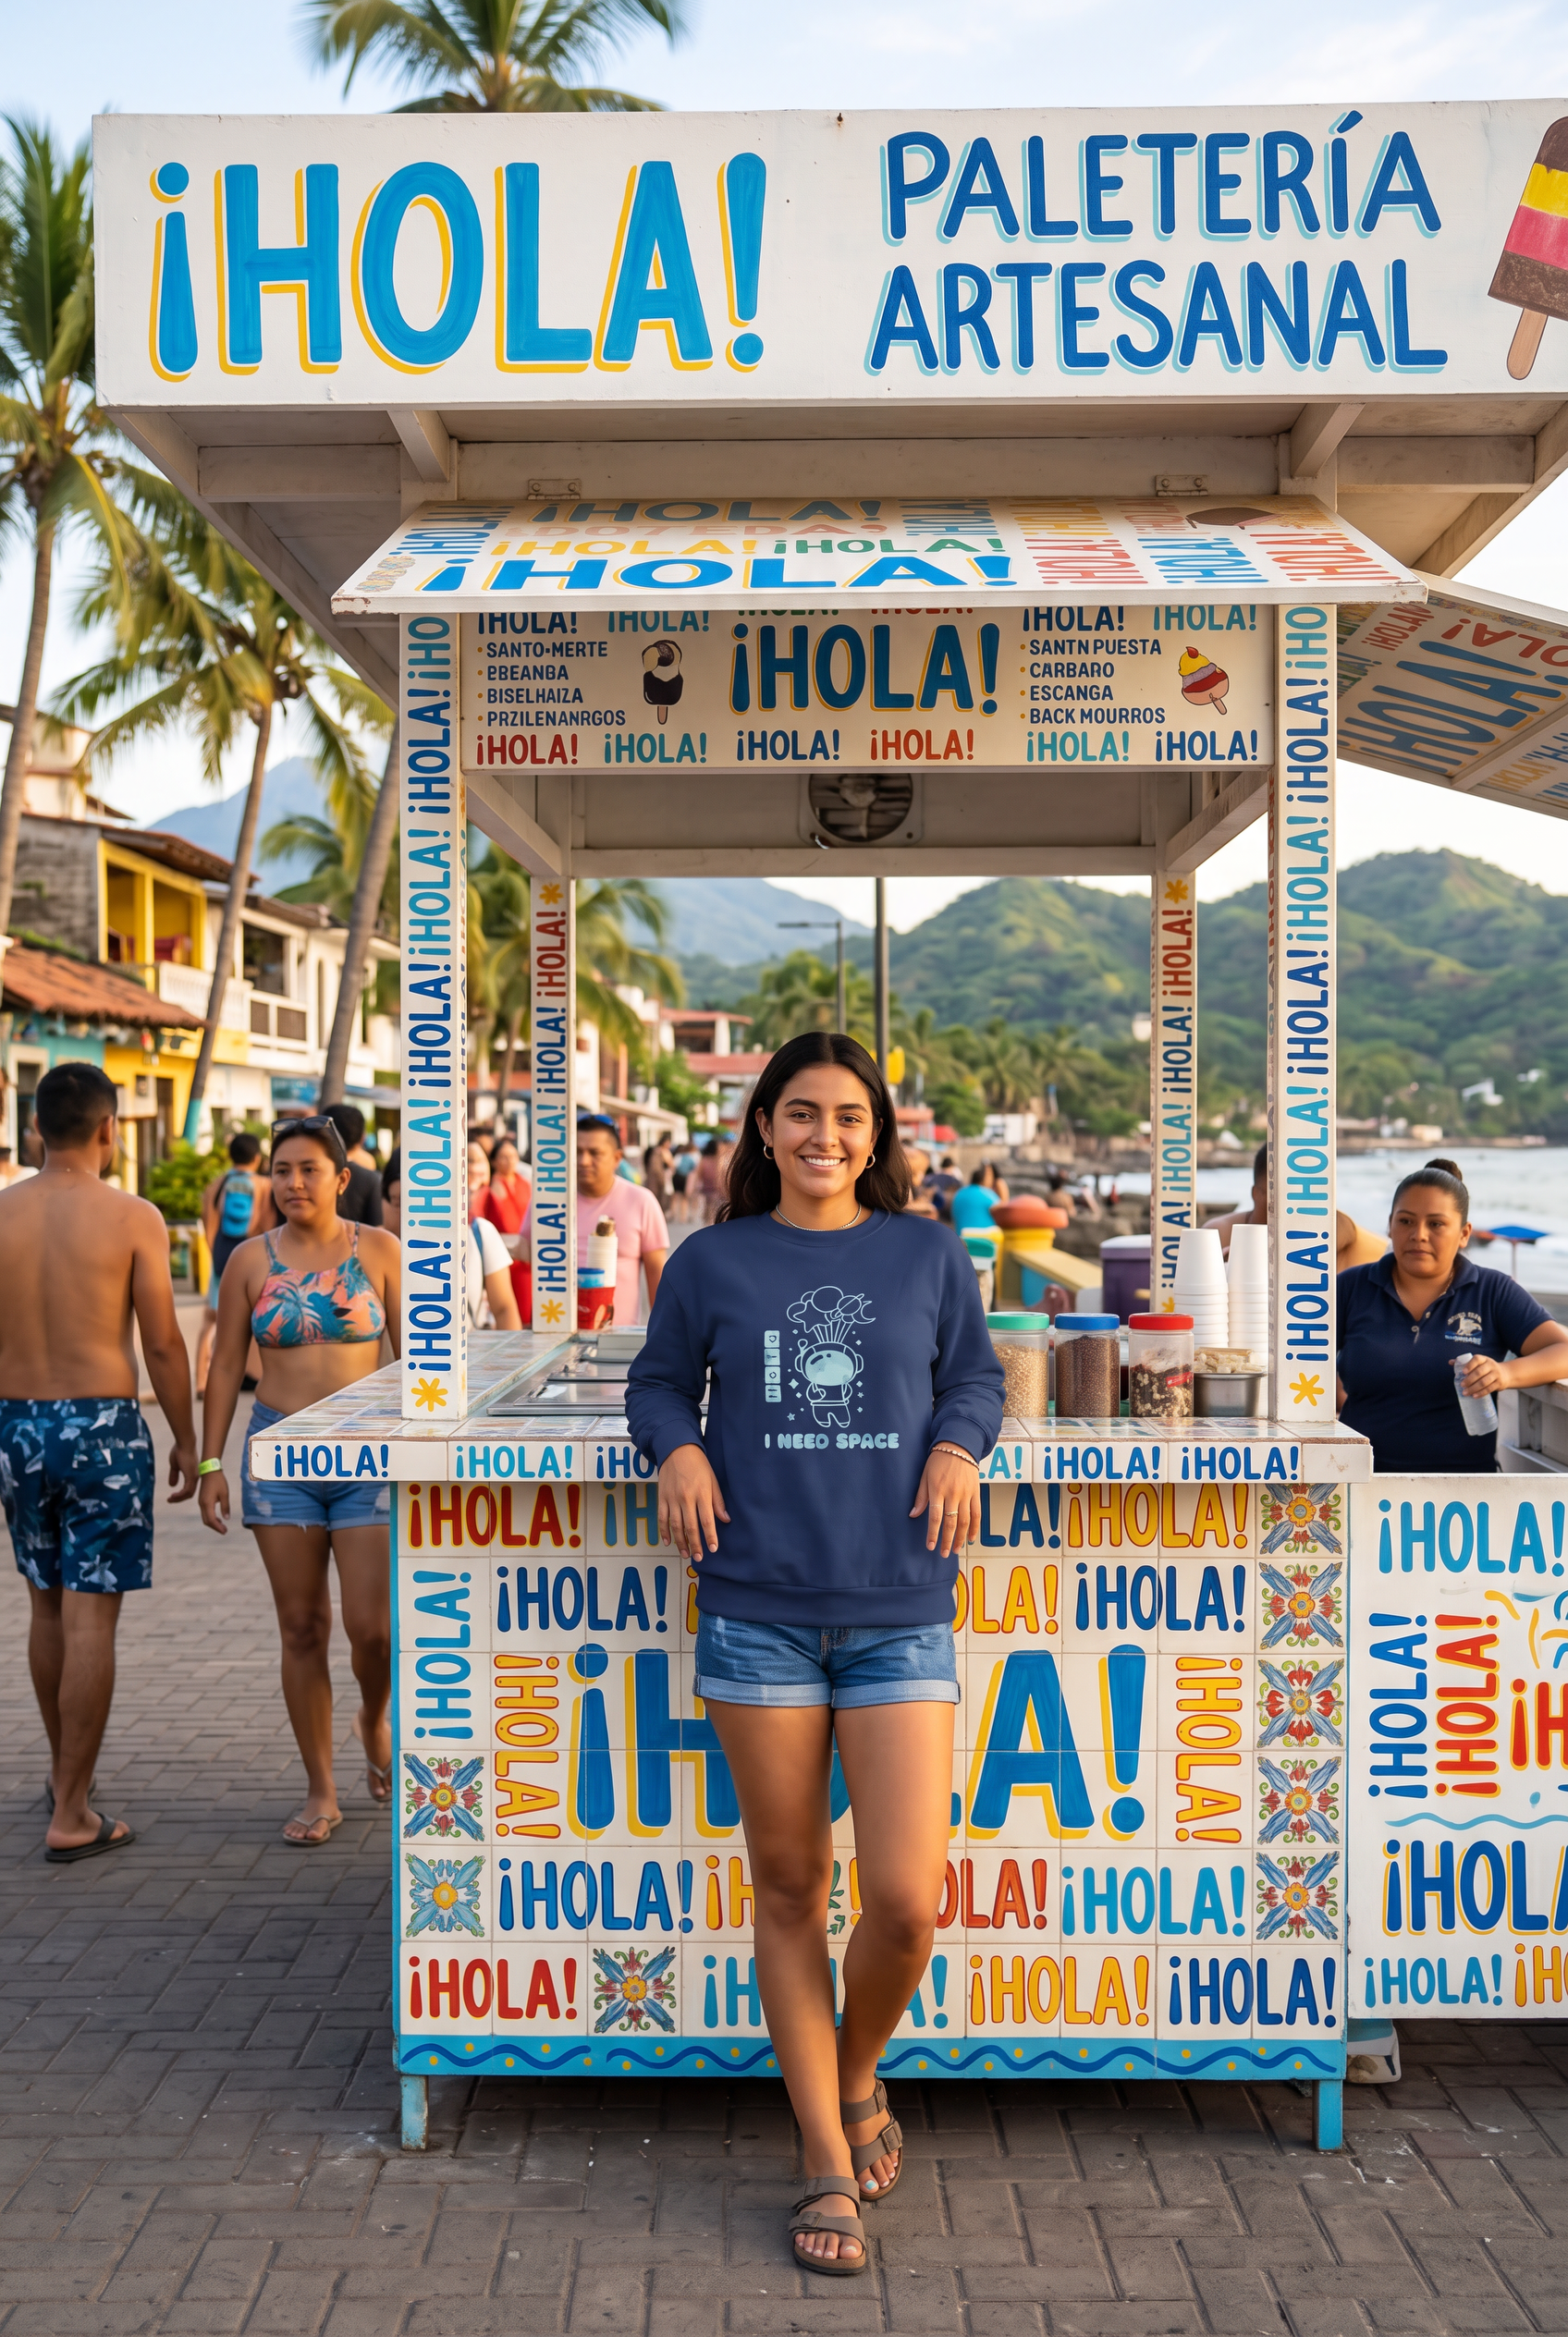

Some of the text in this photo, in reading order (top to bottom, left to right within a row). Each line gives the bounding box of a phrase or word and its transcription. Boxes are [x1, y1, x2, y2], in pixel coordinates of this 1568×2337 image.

[880, 110, 1441, 246] PALETERÍA
[149, 152, 766, 382] ¡HOLA!
[864, 259, 1448, 375] ARTESANAL
[490, 539, 757, 556] ¡HOLA!
[527, 502, 882, 523] ¡HOLA!
[774, 537, 1006, 555] ¡HOLA!
[414, 555, 1018, 591] ¡HOLA!
[1024, 538, 1149, 584] ¡HOLA!
[1137, 537, 1269, 583] ¡HOLA!
[1249, 532, 1402, 581] ¡HOLA!
[729, 622, 1000, 717] ¡HOLA!
[1094, 639, 1162, 655] PUESTA
[487, 688, 584, 704] BISELHAIZA
[1030, 685, 1114, 701] ESCANGA
[1030, 707, 1166, 724] BACK MOURROS
[407, 689, 452, 814] ¡HOLA!
[476, 734, 578, 765] ¡HOLA!
[604, 732, 707, 764] ¡HOLA!
[737, 729, 839, 762] ¡HOLA!
[870, 728, 974, 761] ¡HOLA!
[1026, 730, 1130, 763] ¡HOLA!
[1156, 729, 1258, 762] ¡HOLA!
[1285, 678, 1329, 803] ¡HOLA!
[407, 828, 452, 957] ¡HOLA!
[1285, 815, 1329, 941] ¡HOLA!
[535, 911, 568, 997] ¡HOLA!
[1161, 909, 1193, 997] ¡HOLA!
[407, 963, 452, 1087] ¡HOLA!
[1285, 949, 1329, 1075] ¡HOLA!
[535, 1006, 568, 1095] ¡HOLA!
[1162, 1005, 1193, 1094] ¡HOLA!
[407, 1098, 452, 1230] ¡HOLA!
[535, 1105, 568, 1193] ¡HOLA!
[1161, 1104, 1193, 1193] ¡HOLA!
[1285, 1085, 1329, 1217] ¡HOLA!
[535, 1203, 568, 1293] ¡HOLA!
[407, 1239, 452, 1372] ¡HOLA!
[1285, 1230, 1329, 1362] ¡HOLA!
[274, 1444, 389, 1478] ¡HOLA!
[456, 1445, 573, 1479] ¡HOLA!
[765, 1433, 900, 1449] I NEED SPACE
[1044, 1445, 1160, 1481] ¡HOLA!
[1182, 1445, 1299, 1481] ¡HOLA!
[408, 1483, 582, 1548] ¡HOLA!
[1068, 1483, 1249, 1549] ¡HOLA!
[1378, 1499, 1565, 1574] ¡HOLA!
[496, 1565, 668, 1633] ¡HOLA!
[1075, 1562, 1247, 1633] ¡HOLA!
[412, 1570, 473, 1740] ¡HOLA!
[1367, 1612, 1427, 1799] ¡HOLA!
[1434, 1613, 1501, 1798] ¡HOLA!
[494, 1654, 562, 1840] ¡HOLA!
[1175, 1657, 1243, 1844] ¡HOLA!
[498, 1857, 694, 1934] ¡HOLA!
[1061, 1865, 1246, 1937] ¡HOLA!
[409, 1955, 578, 2021] ¡HOLA!
[970, 1954, 1149, 2027] ¡HOLA!
[1169, 1955, 1337, 2028] ¡HOLA!
[1365, 1953, 1503, 2007] ¡HOLA!
